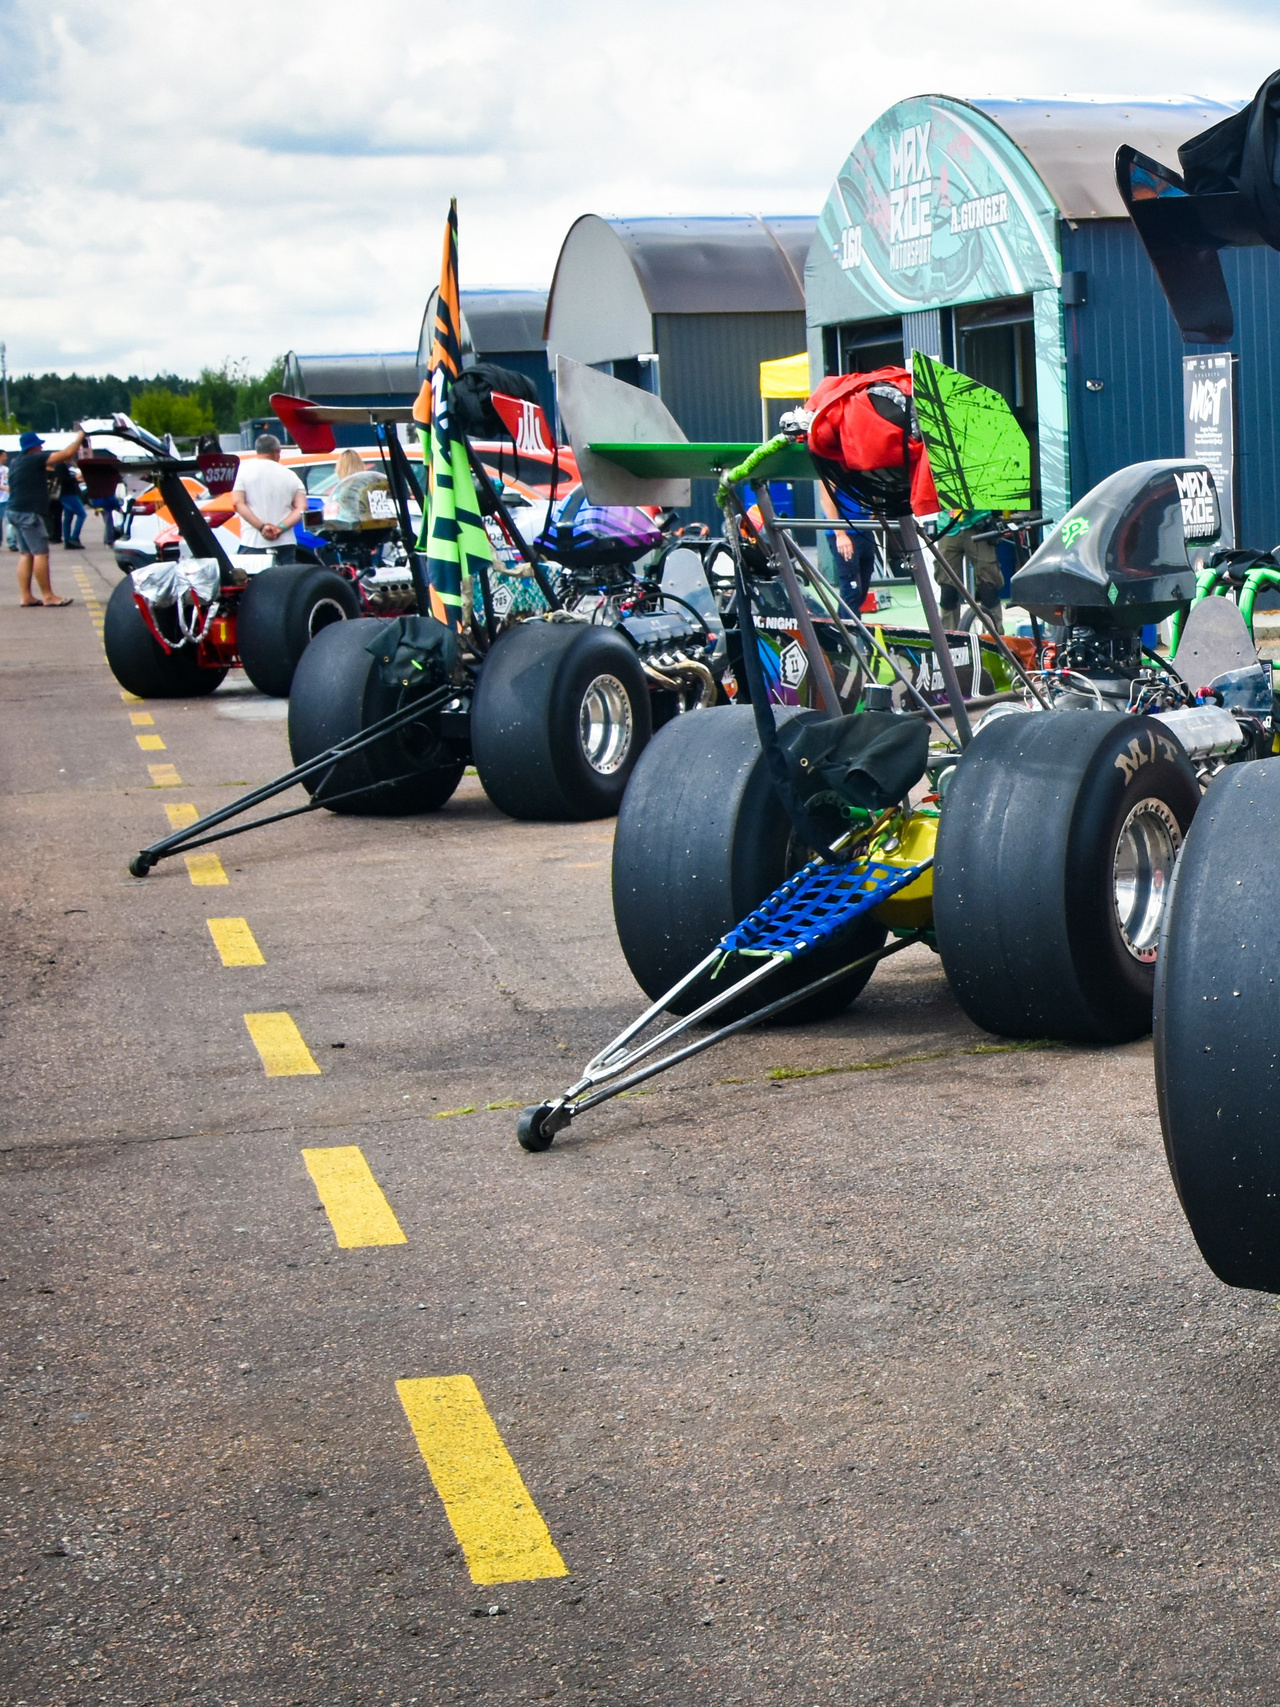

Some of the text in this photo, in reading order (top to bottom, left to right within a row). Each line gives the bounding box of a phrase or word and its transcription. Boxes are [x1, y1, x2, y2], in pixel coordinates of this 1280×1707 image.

[889, 120, 932, 190] MAX
[890, 179, 932, 244] RIDE
[950, 192, 1008, 235] A.GUNGER
[1174, 471, 1212, 498] MAX
[1181, 497, 1215, 525] RIDE
[766, 616, 798, 630] NIGHT
